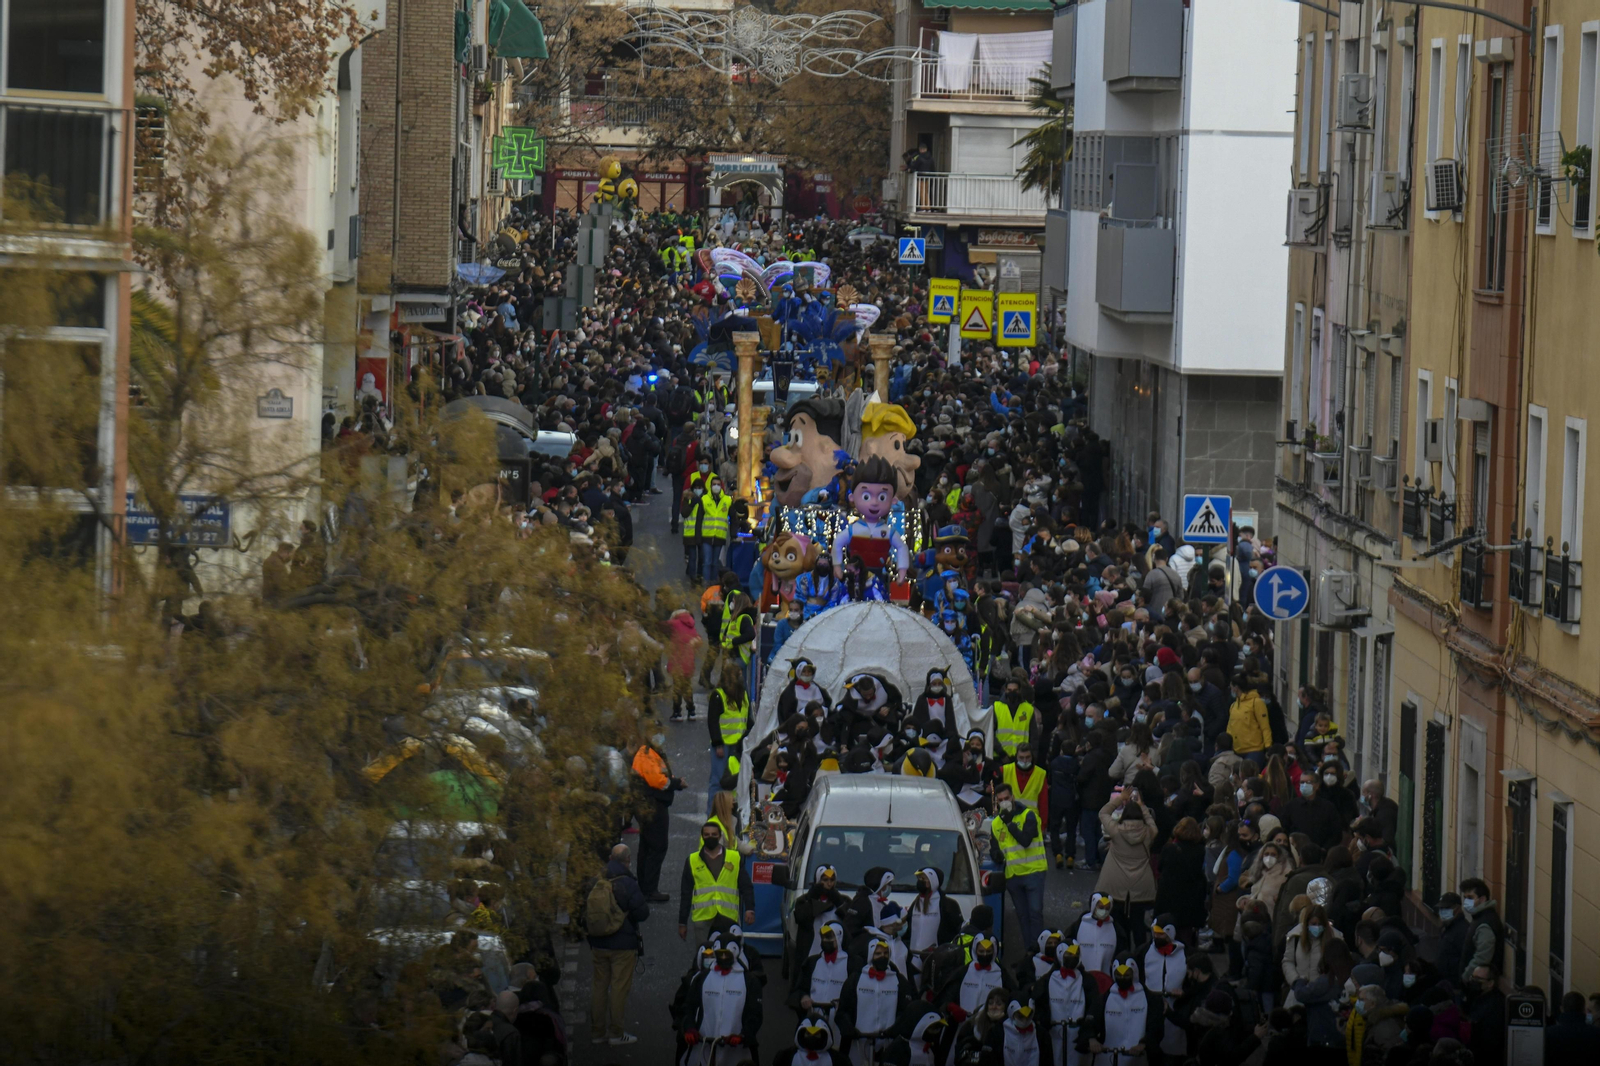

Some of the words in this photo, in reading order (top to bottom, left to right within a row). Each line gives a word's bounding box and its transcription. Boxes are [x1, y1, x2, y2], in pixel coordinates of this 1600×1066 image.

[714, 163, 777, 173] BORRIQUILLA
[562, 170, 591, 180] PUERTA
[645, 173, 675, 182] PUERTA
